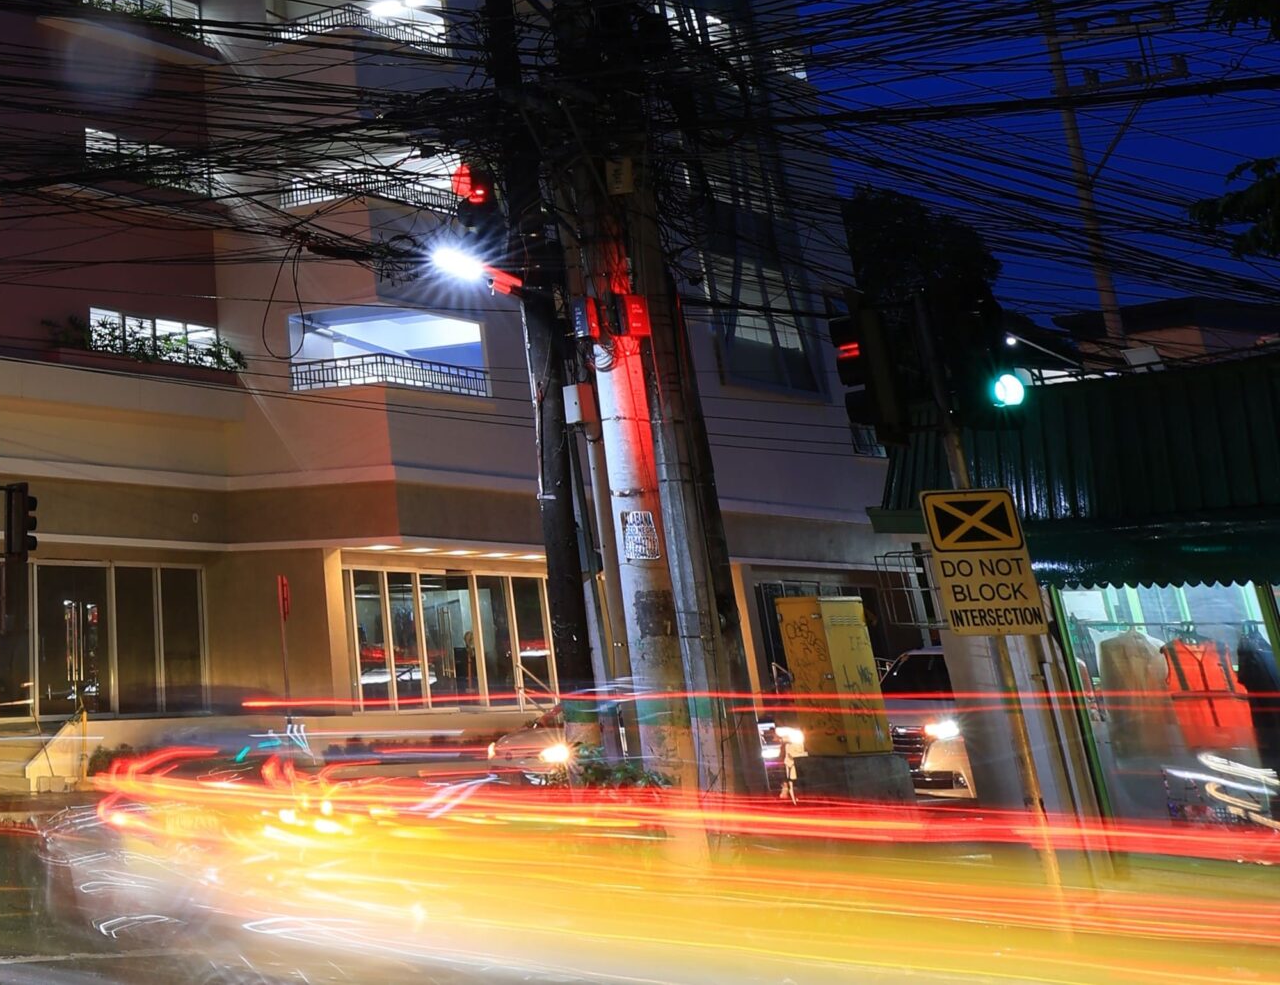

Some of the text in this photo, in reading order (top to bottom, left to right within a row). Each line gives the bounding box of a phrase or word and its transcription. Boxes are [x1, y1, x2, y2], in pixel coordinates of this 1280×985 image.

[940, 557, 1024, 578] DO NOT
[951, 582, 1028, 602] BLOCK
[949, 606, 1044, 627] INTERSECTION
